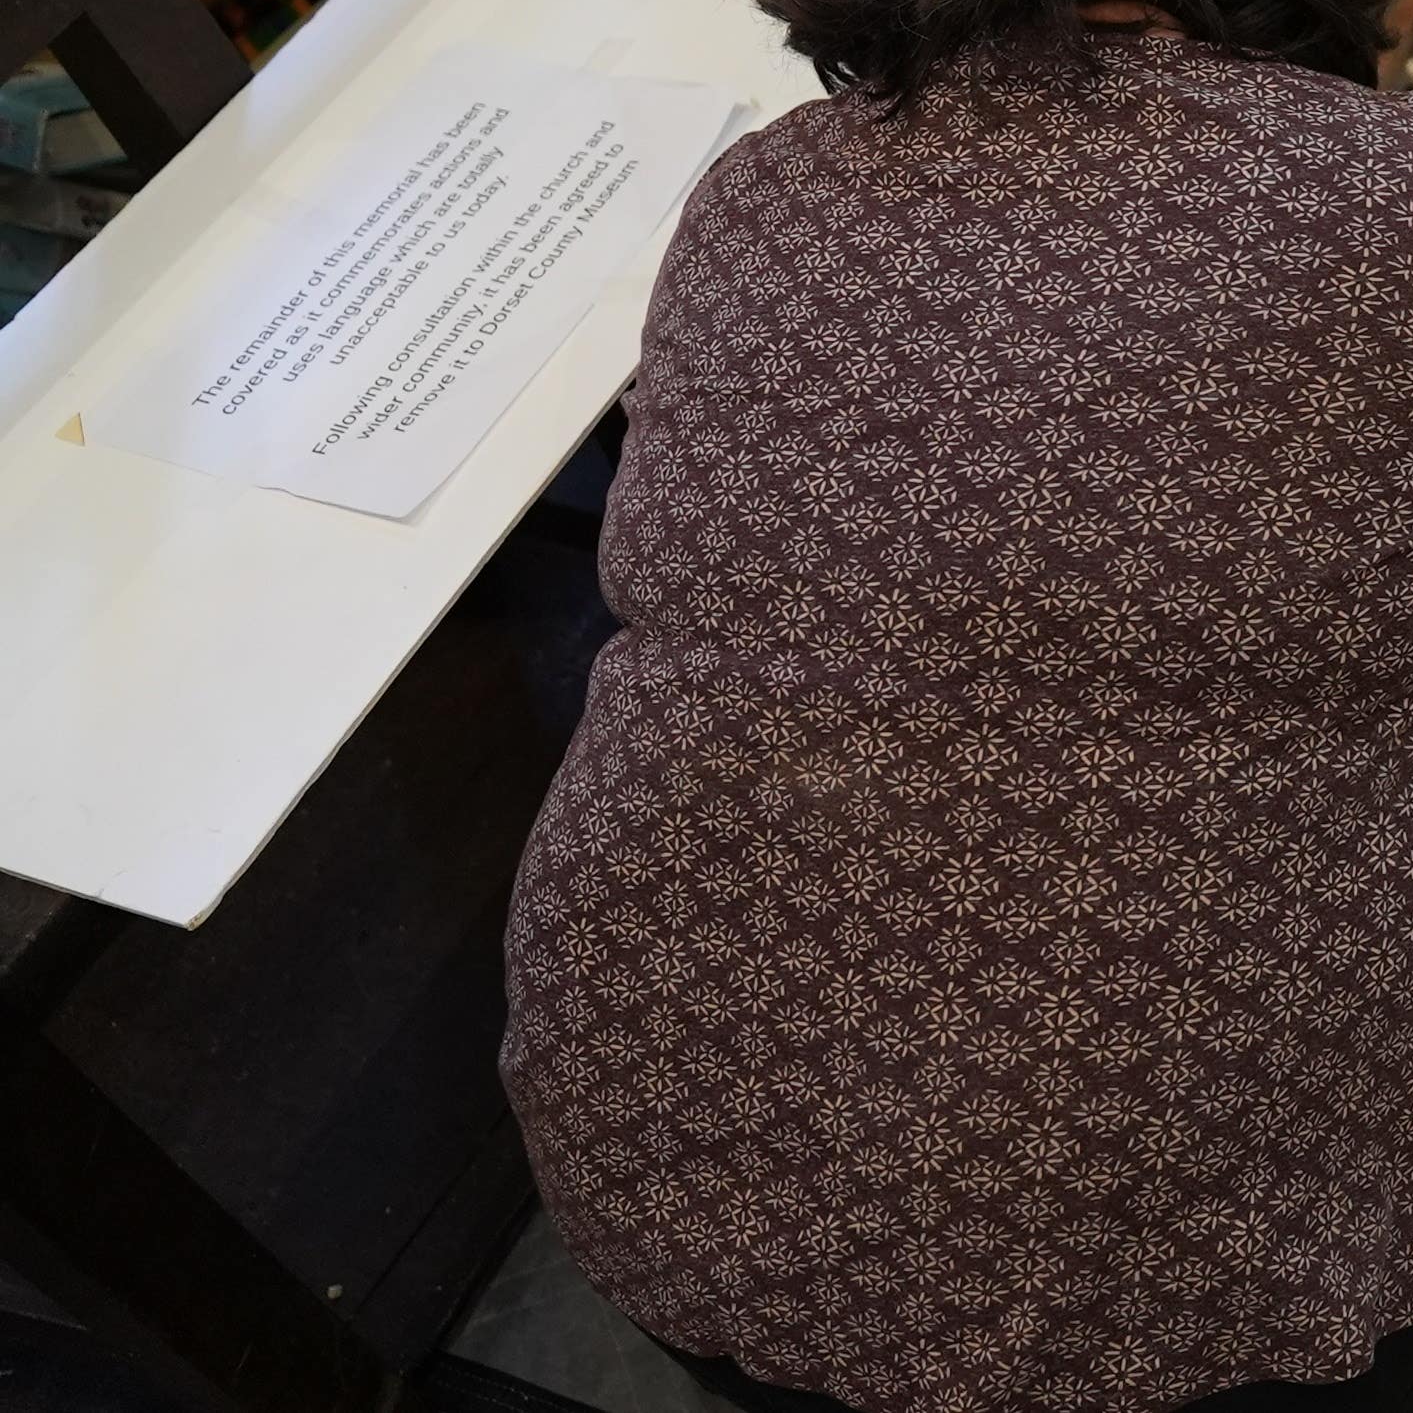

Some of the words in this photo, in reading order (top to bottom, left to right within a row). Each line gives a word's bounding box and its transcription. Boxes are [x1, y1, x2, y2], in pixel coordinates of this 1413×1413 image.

[190, 375, 232, 406] The
[229, 289, 309, 372] remainder
[307, 269, 327, 287] of
[322, 240, 356, 268] this
[352, 169, 423, 238] memorial
[415, 141, 451, 168] has
[443, 102, 486, 139] been
[221, 347, 289, 416] covered
[284, 325, 310, 346] as
[302, 310, 324, 322] it
[319, 192, 433, 309] commemorates
[429, 138, 483, 190] actions
[479, 107, 510, 137] and
[282, 343, 325, 383] uses
[316, 266, 393, 341] language
[389, 220, 437, 263] which
[433, 192, 462, 218] are
[456, 145, 505, 190] totally
[311, 375, 394, 456] Following
[387, 276, 477, 373] consultation
[471, 230, 519, 274] within
[512, 202, 543, 227] the
[539, 150, 589, 201] church
[585, 120, 616, 149] and
[329, 260, 430, 366] unacceptable
[424, 242, 447, 258] to
[442, 220, 467, 239] us
[461, 175, 509, 218] today.
[356, 395, 404, 440] wider
[401, 303, 489, 393] community,
[478, 287, 500, 299] it
[490, 256, 527, 285] has
[518, 215, 563, 254] been
[558, 159, 610, 213] agreed
[603, 143, 625, 159] to
[393, 373, 457, 433] remove
[448, 358, 471, 371] it
[462, 338, 485, 356] to
[477, 283, 534, 336] Dorset
[527, 225, 584, 281] County
[575, 159, 639, 223] Museum
